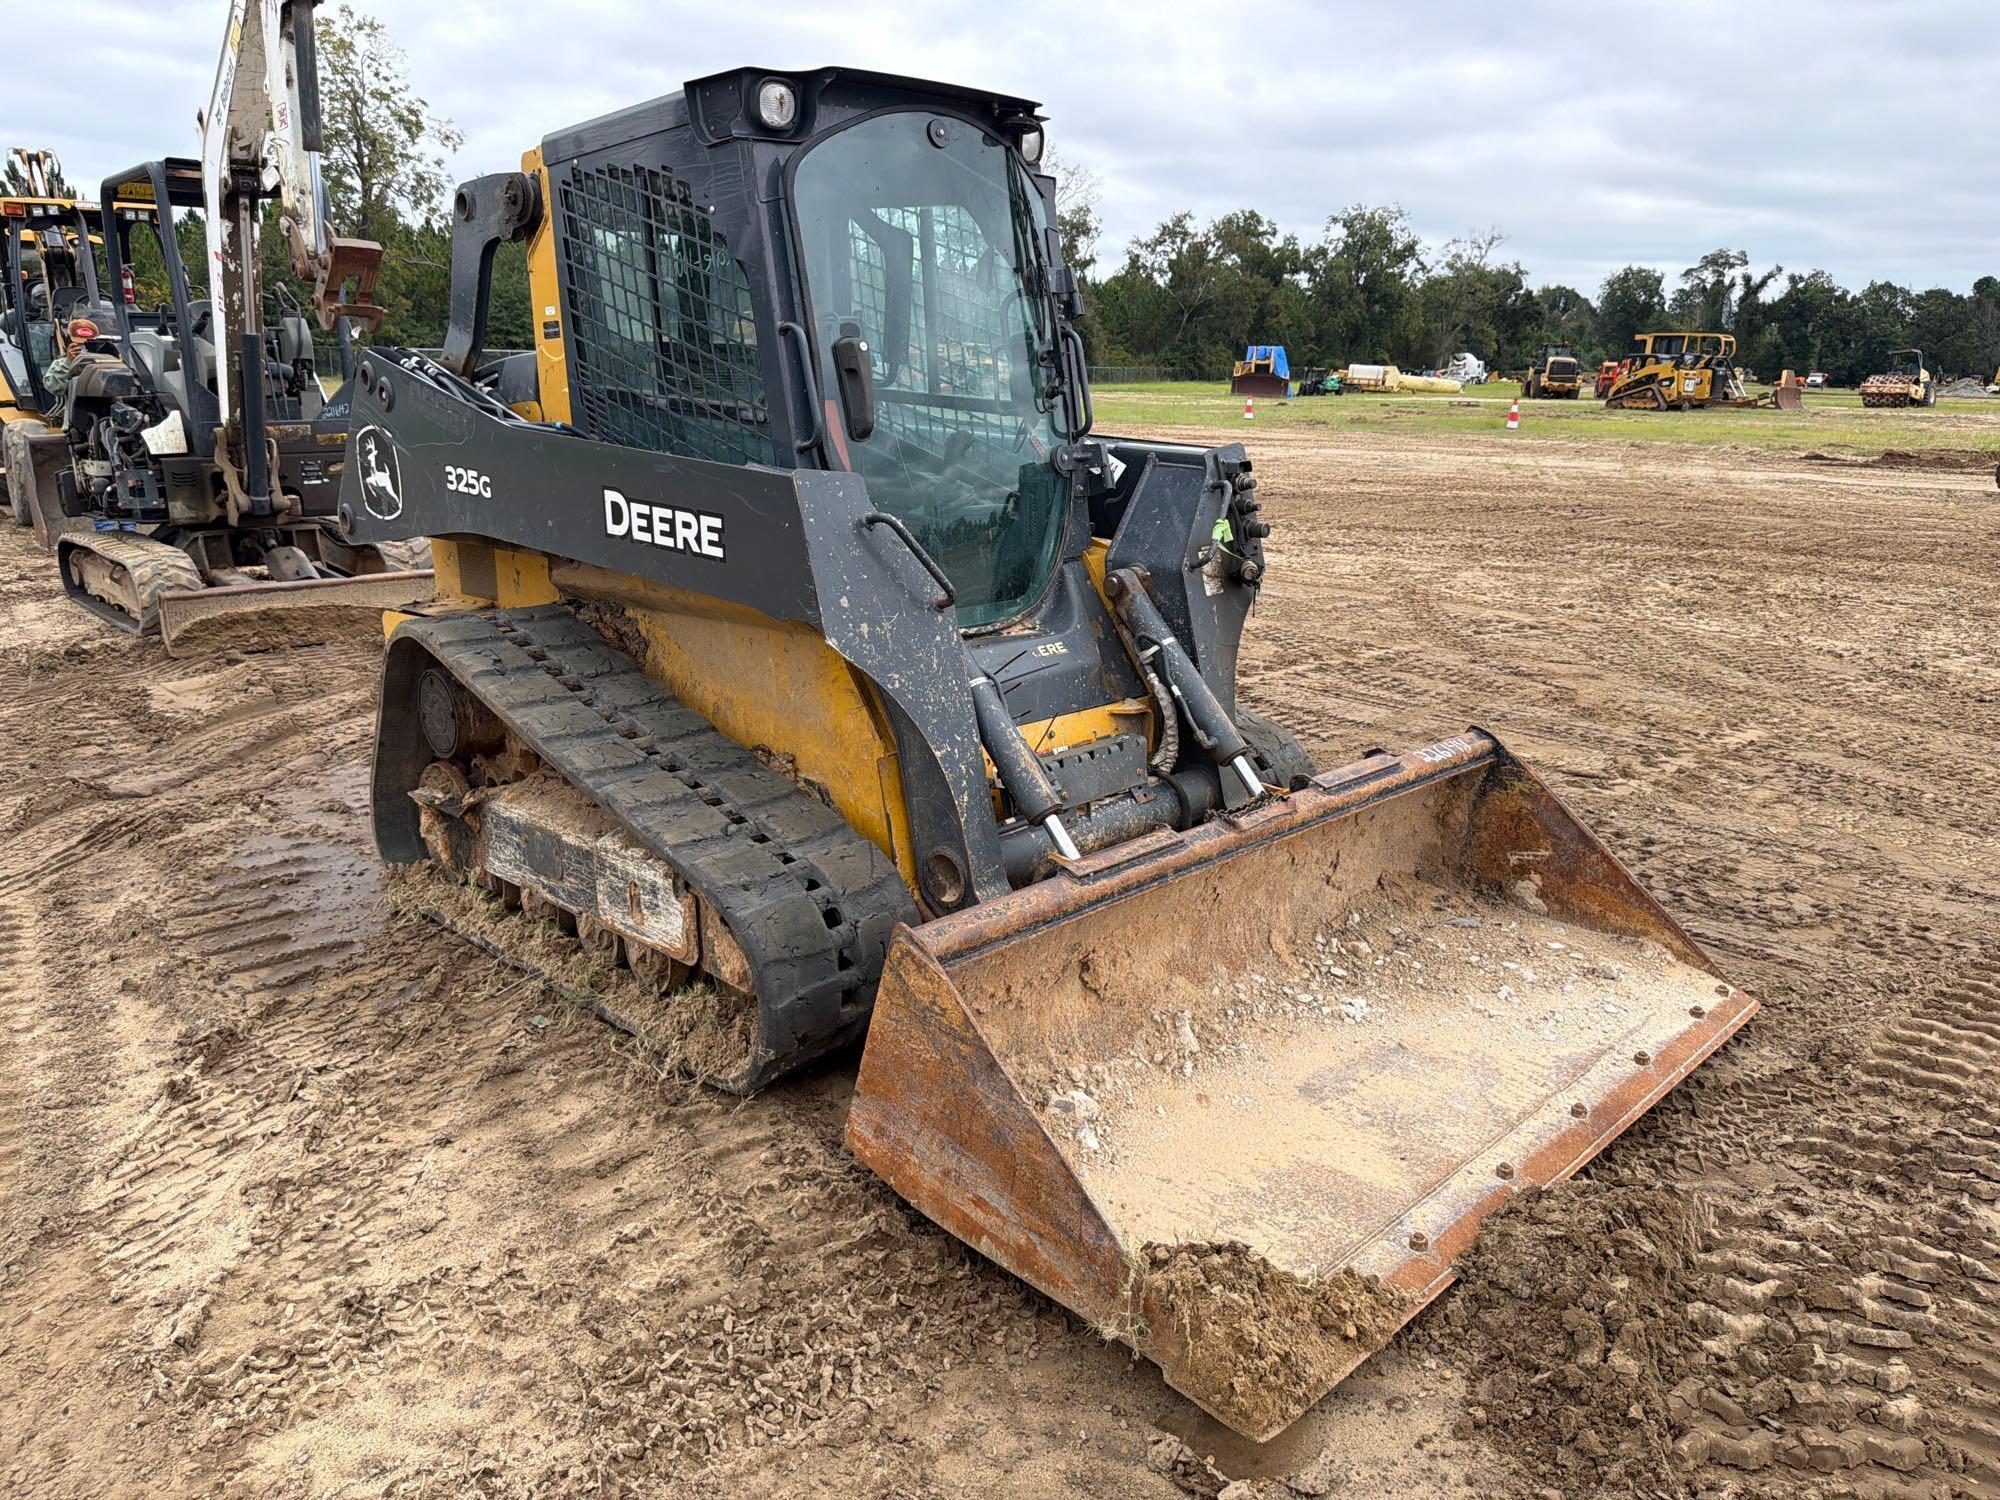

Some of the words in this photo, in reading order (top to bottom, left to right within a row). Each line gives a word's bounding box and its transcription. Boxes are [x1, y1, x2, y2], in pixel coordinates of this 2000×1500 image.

[445, 465, 492, 498] 325G
[603, 489, 724, 558] DEERE
[1031, 641, 1068, 658] ERE
